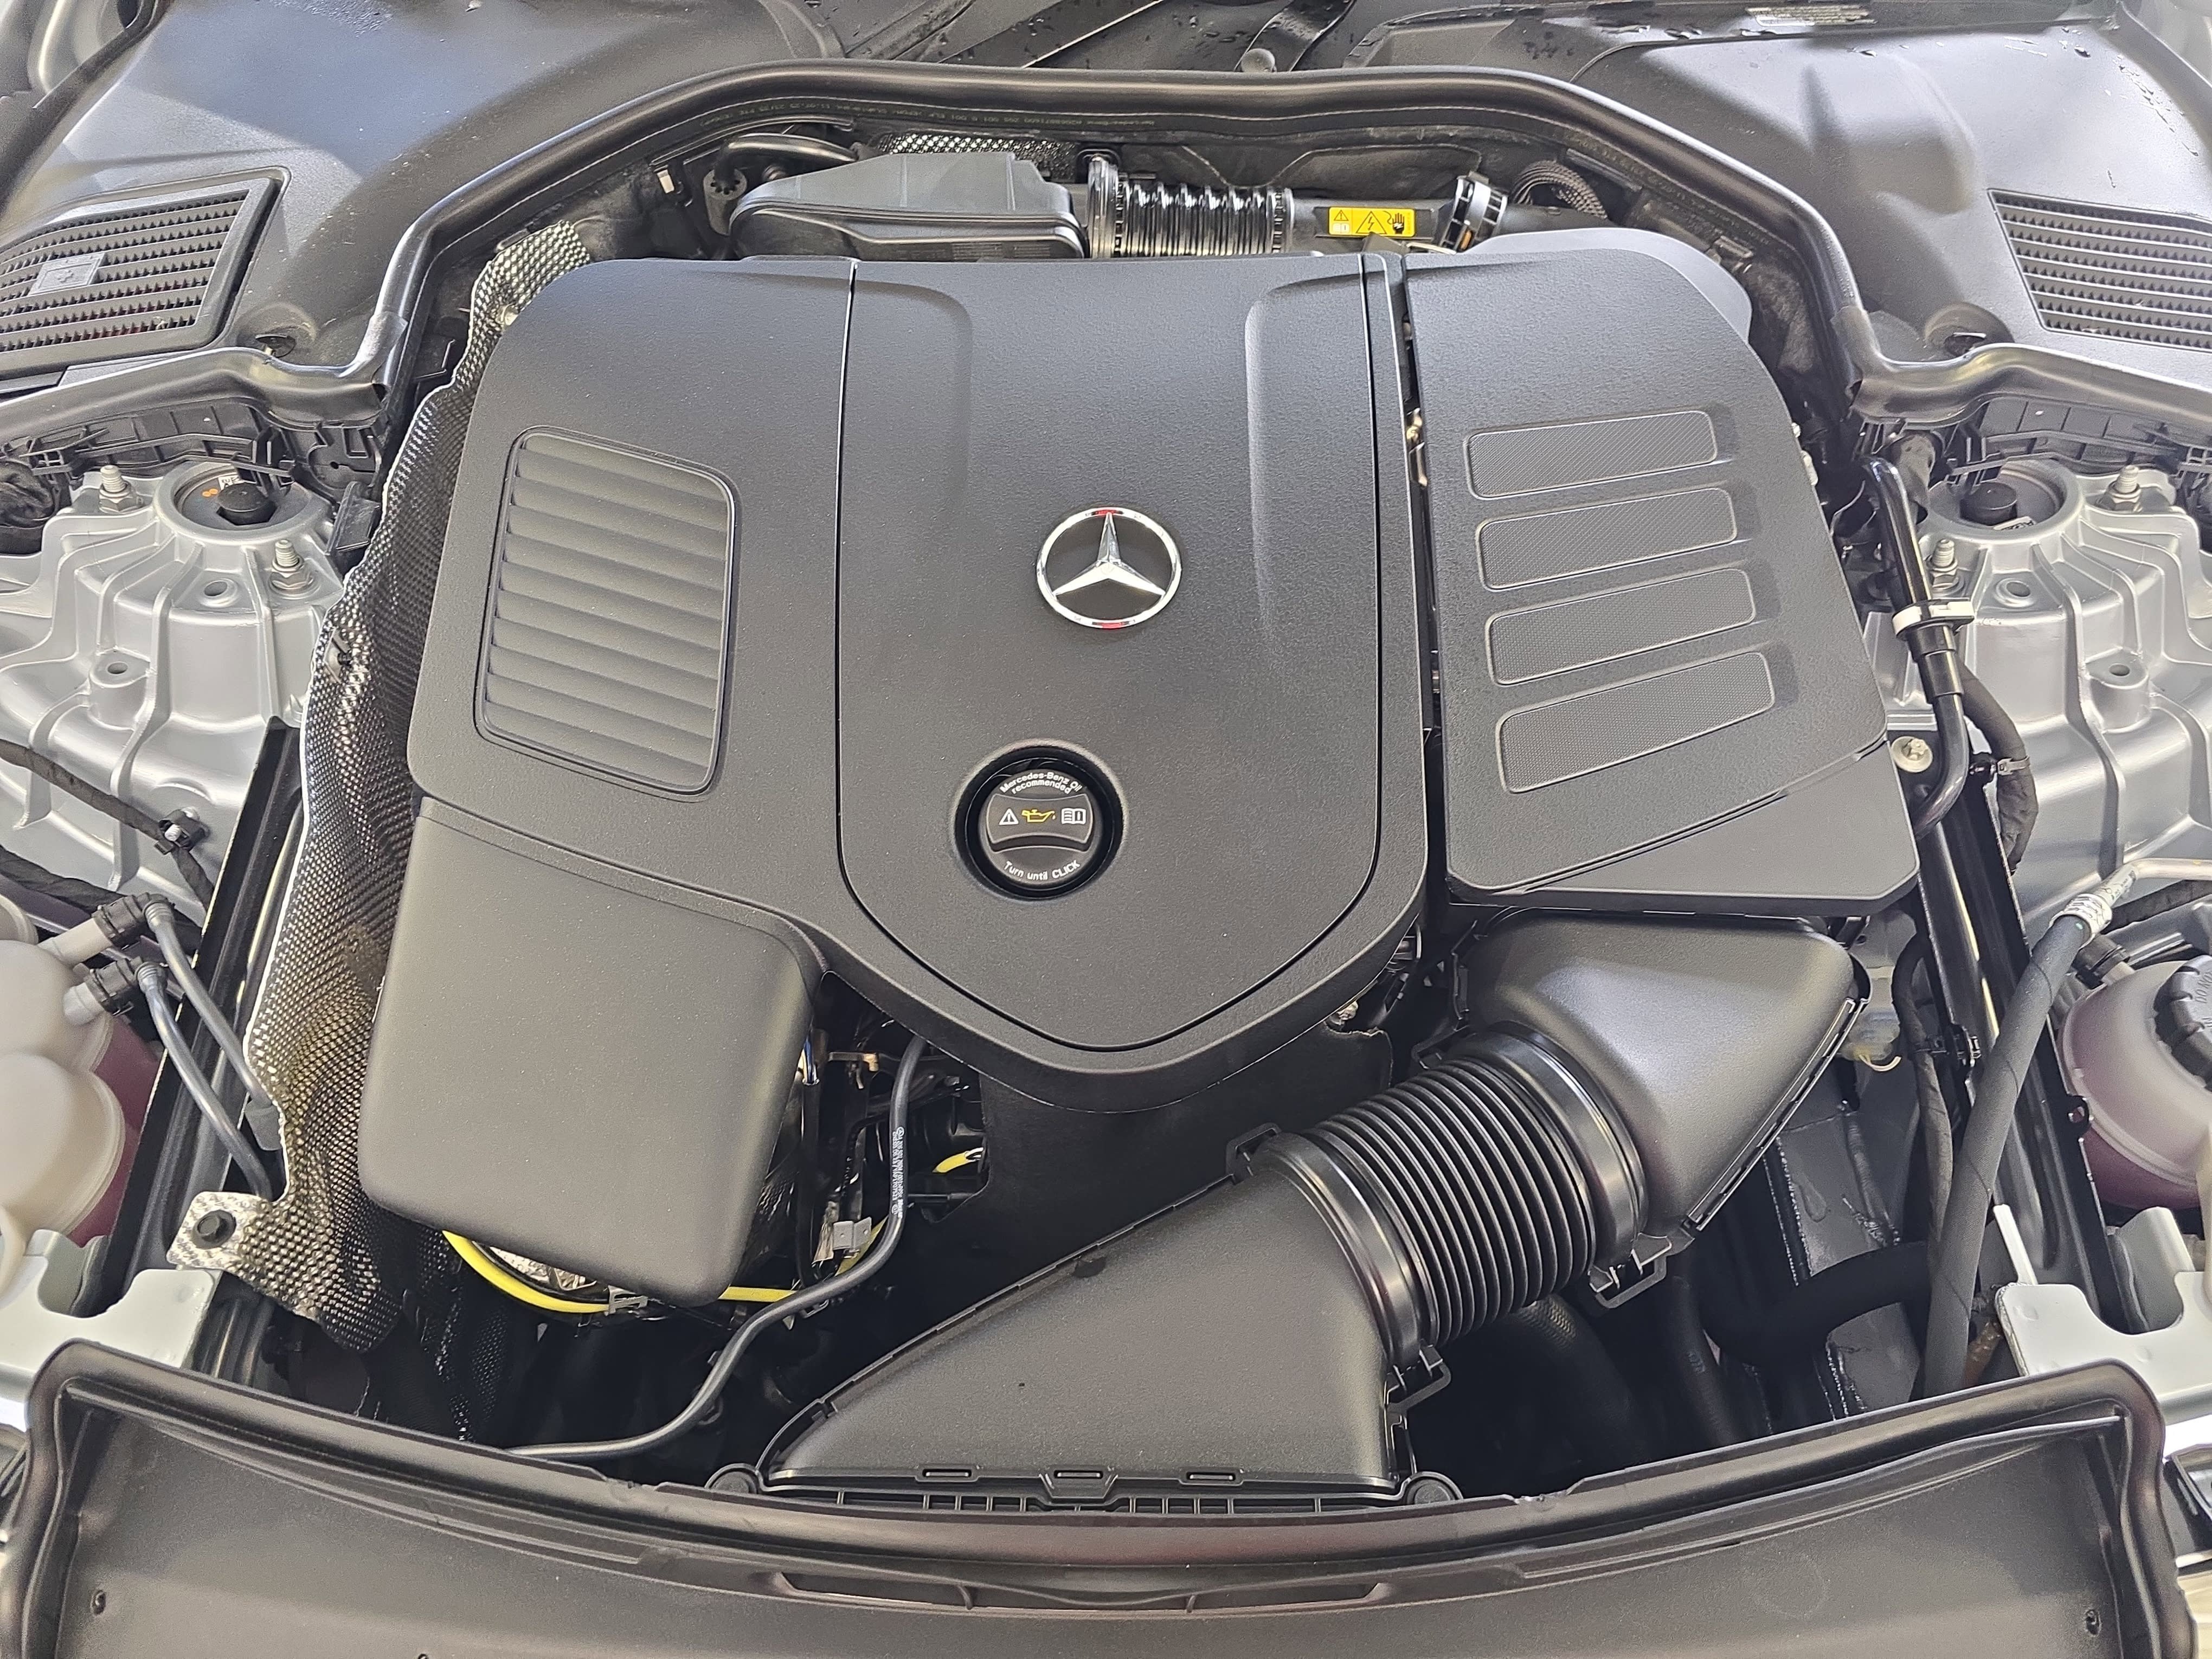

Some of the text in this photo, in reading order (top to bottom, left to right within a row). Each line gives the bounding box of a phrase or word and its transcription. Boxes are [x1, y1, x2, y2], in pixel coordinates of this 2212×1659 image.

[1000, 771, 1083, 793] Mercedes-Benz Oil
[1011, 780, 1072, 794] recommended
[1003, 860, 1081, 880] Turn until CLICK
